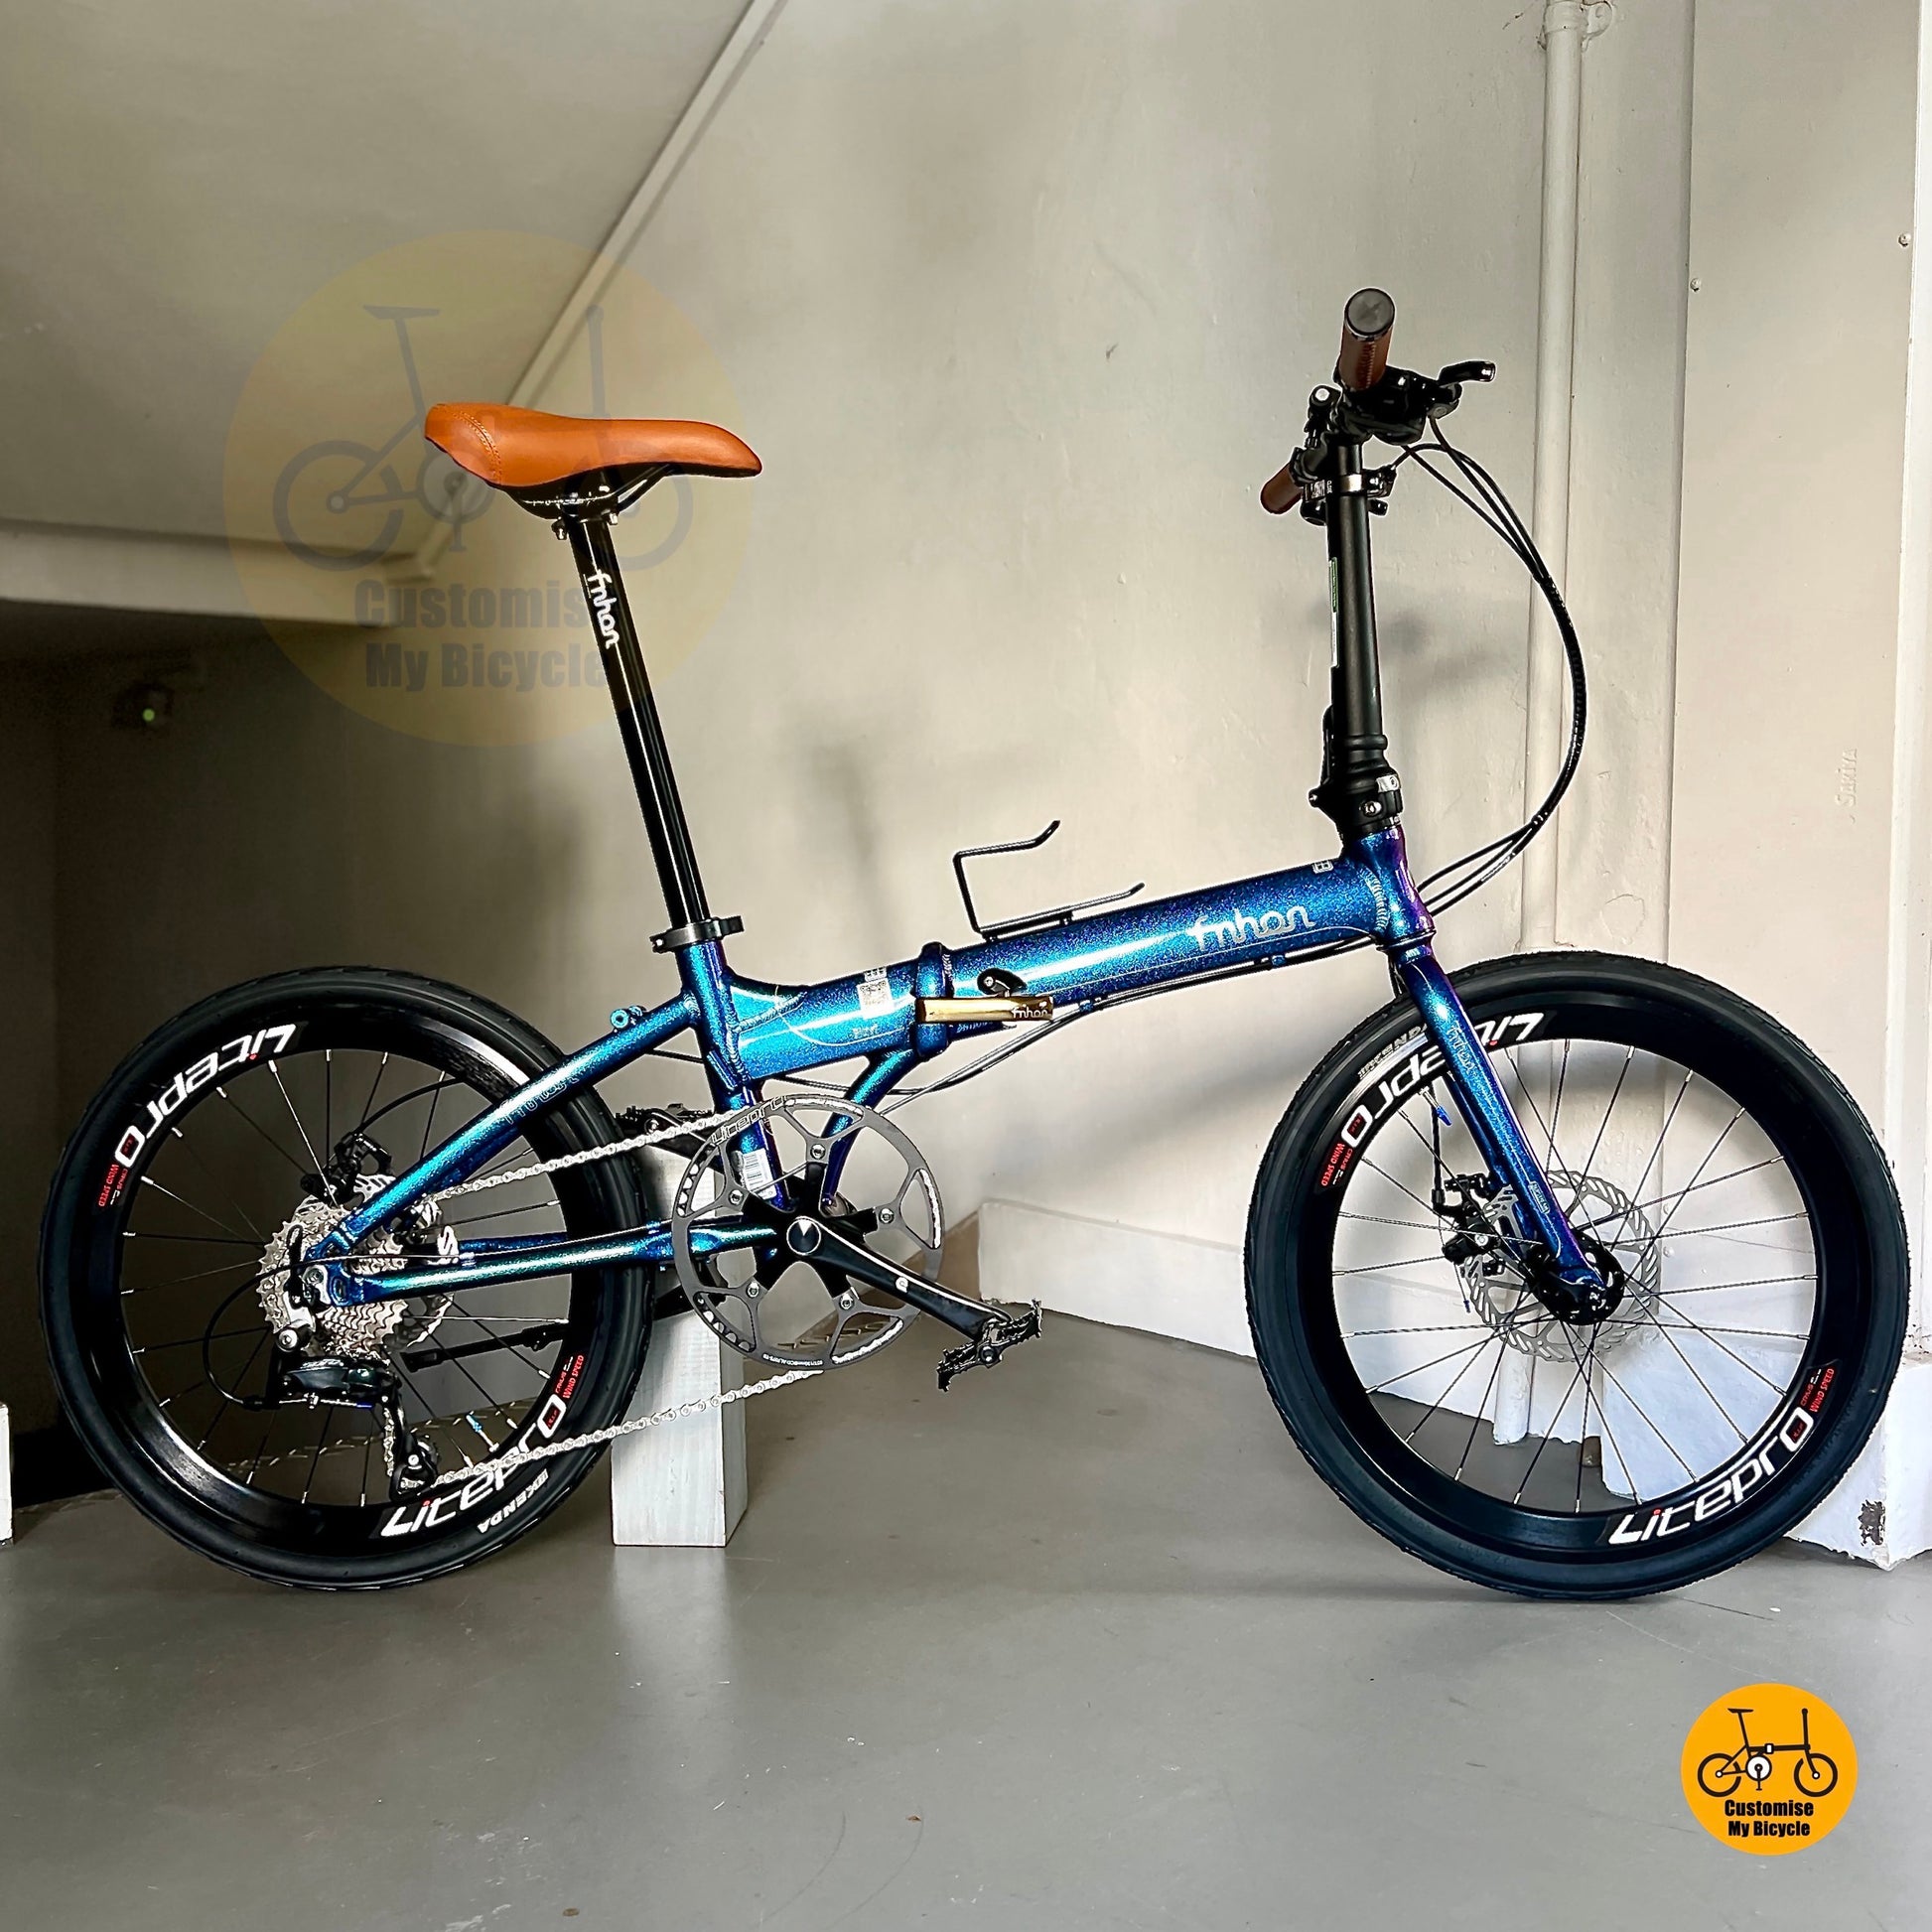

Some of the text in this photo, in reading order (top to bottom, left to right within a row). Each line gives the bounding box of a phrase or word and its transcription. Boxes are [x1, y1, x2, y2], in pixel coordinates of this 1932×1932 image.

[588, 569, 621, 650] fnhon
[1186, 903, 1316, 951] fnhon
[1011, 1005, 1049, 1019] fnhon
[1330, 1143, 1345, 1165] WIND
[105, 1164, 119, 1184] WIND
[1320, 1164, 1335, 1186] SPEED
[98, 1184, 111, 1207] SPEED
[562, 1377, 576, 1399] WIND
[571, 1354, 584, 1378] SPEED
[1809, 1390, 1825, 1412] WIND
[1820, 1368, 1835, 1391] SPEED
[477, 1474, 541, 1534] KENDA
